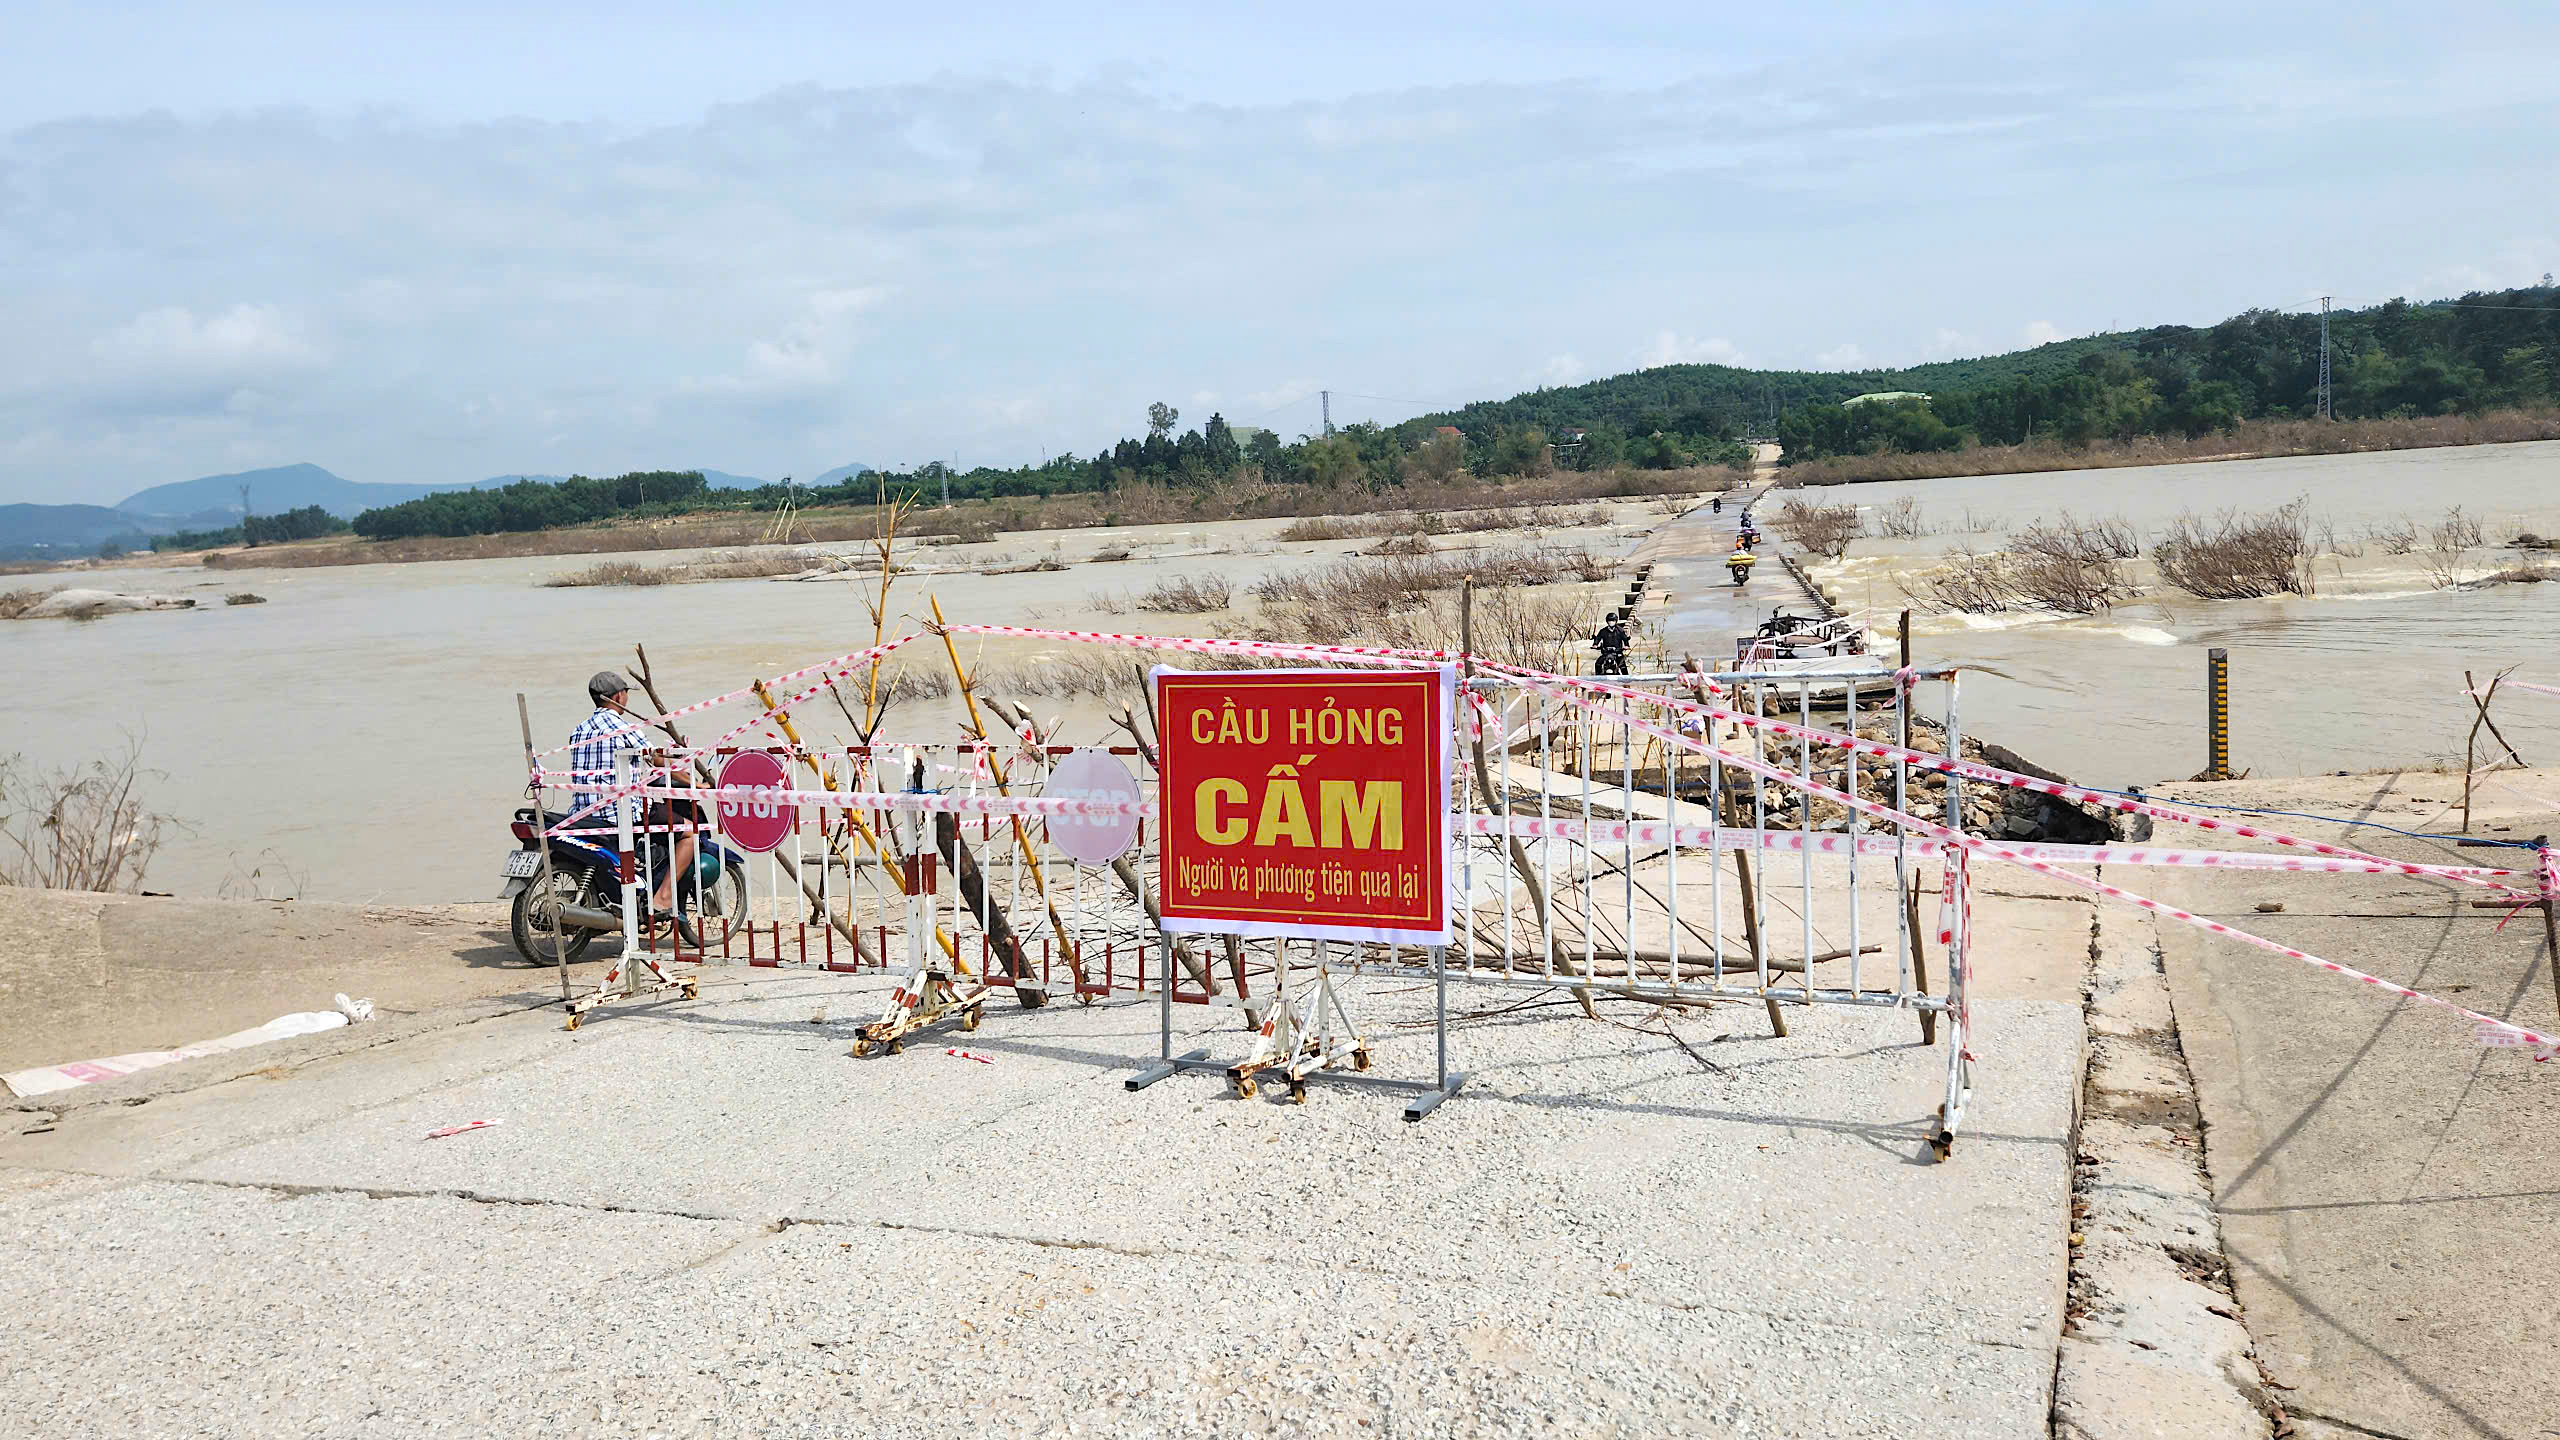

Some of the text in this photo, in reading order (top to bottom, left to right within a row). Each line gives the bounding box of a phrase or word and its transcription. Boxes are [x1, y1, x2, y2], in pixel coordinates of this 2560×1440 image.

[1191, 696, 1403, 745] CẦU HỎNG
[1195, 754, 1403, 850] CẤM
[1179, 856, 1418, 905] Người và phương tiện qua lại
